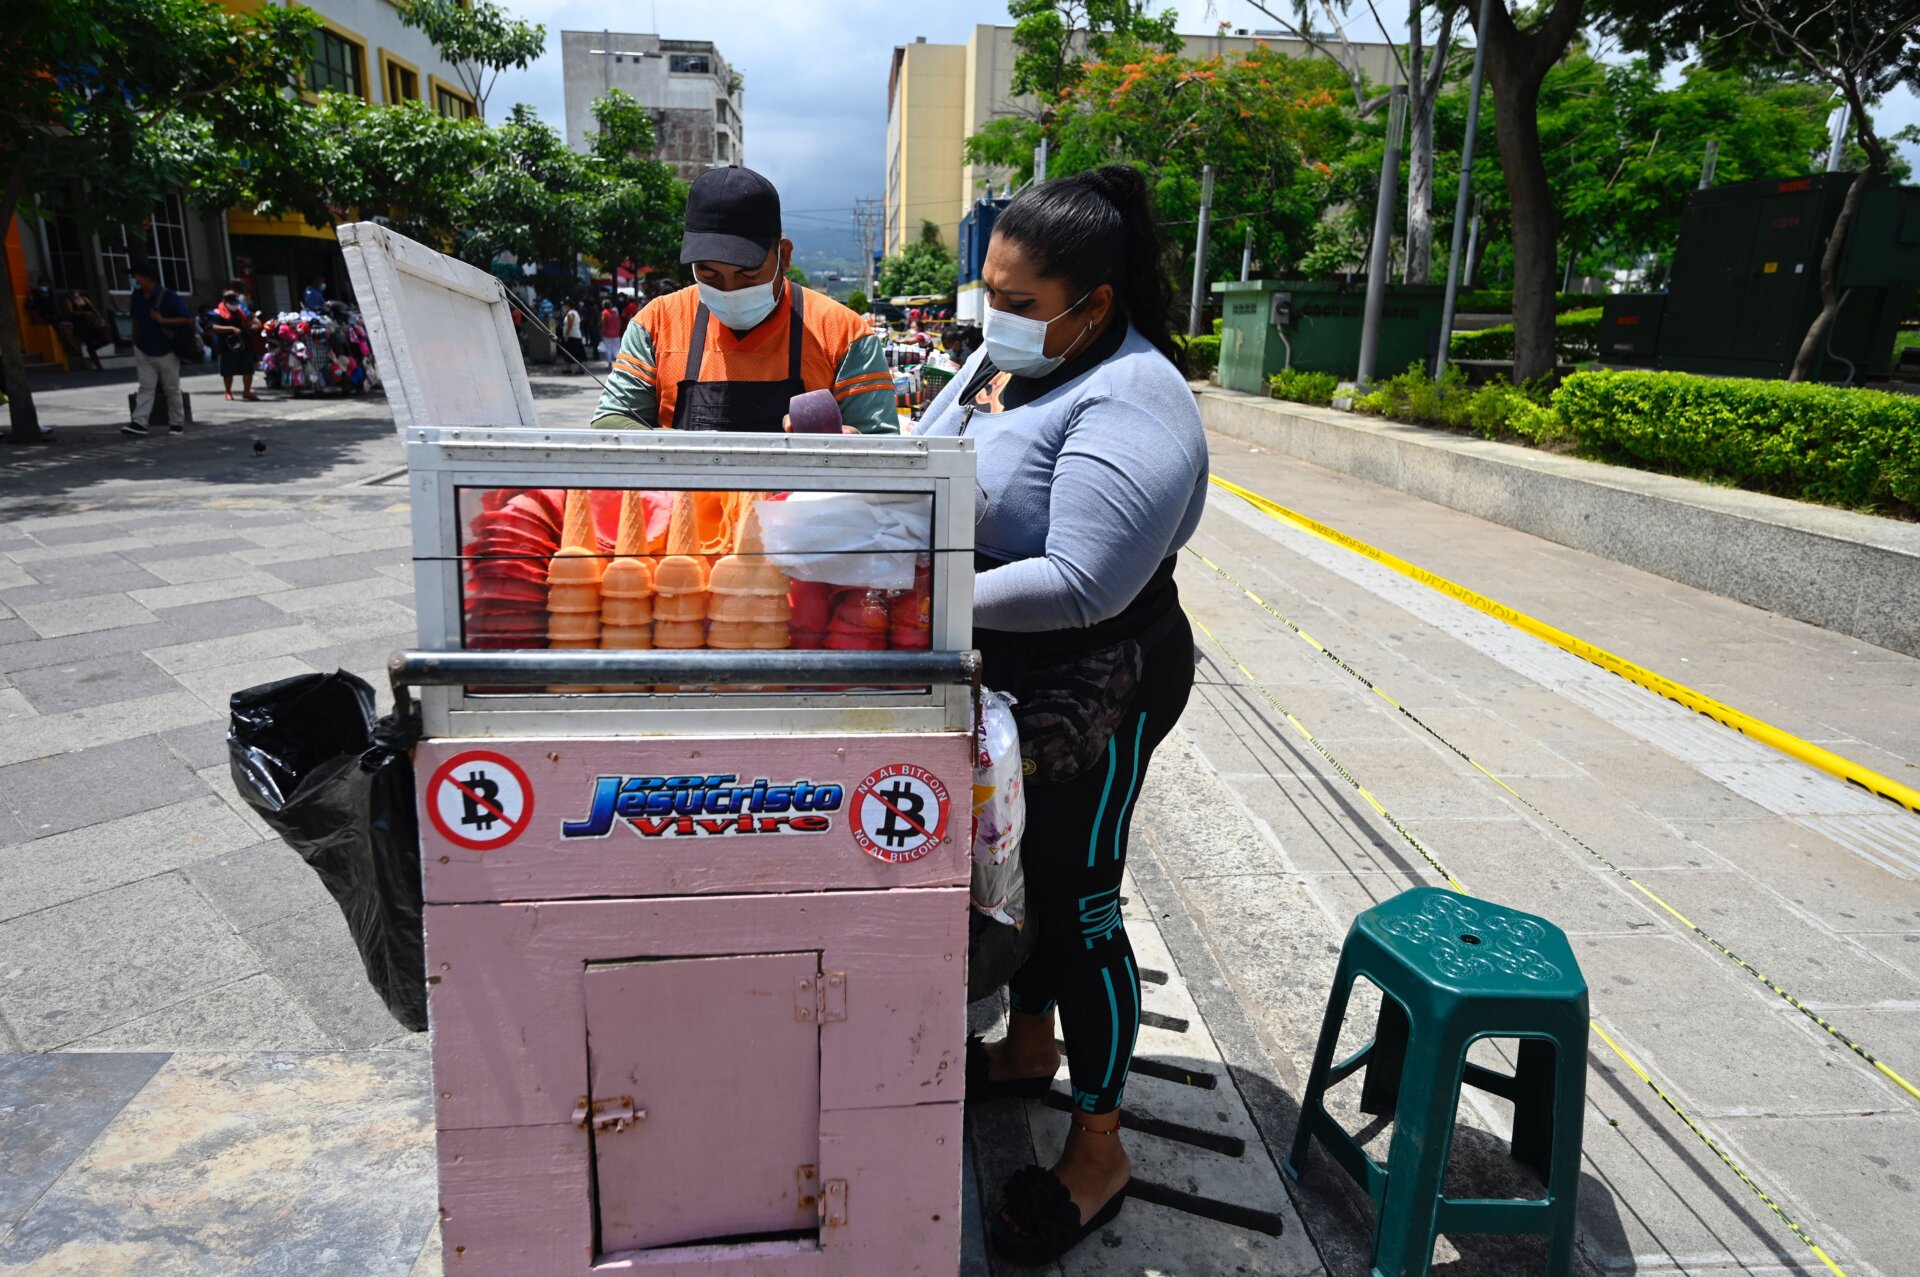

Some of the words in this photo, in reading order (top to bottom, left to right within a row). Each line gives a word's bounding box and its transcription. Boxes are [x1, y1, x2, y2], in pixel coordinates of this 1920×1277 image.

[623, 774, 738, 791] por
[858, 776, 876, 794] NO
[880, 766, 897, 778] AL
[902, 765, 947, 801] BITCOIN
[562, 775, 844, 838] Jesucristo
[854, 828, 869, 847] NO
[870, 846, 884, 860] AL
[890, 835, 940, 862] BITCOIN
[1078, 884, 1123, 950] LOVE
